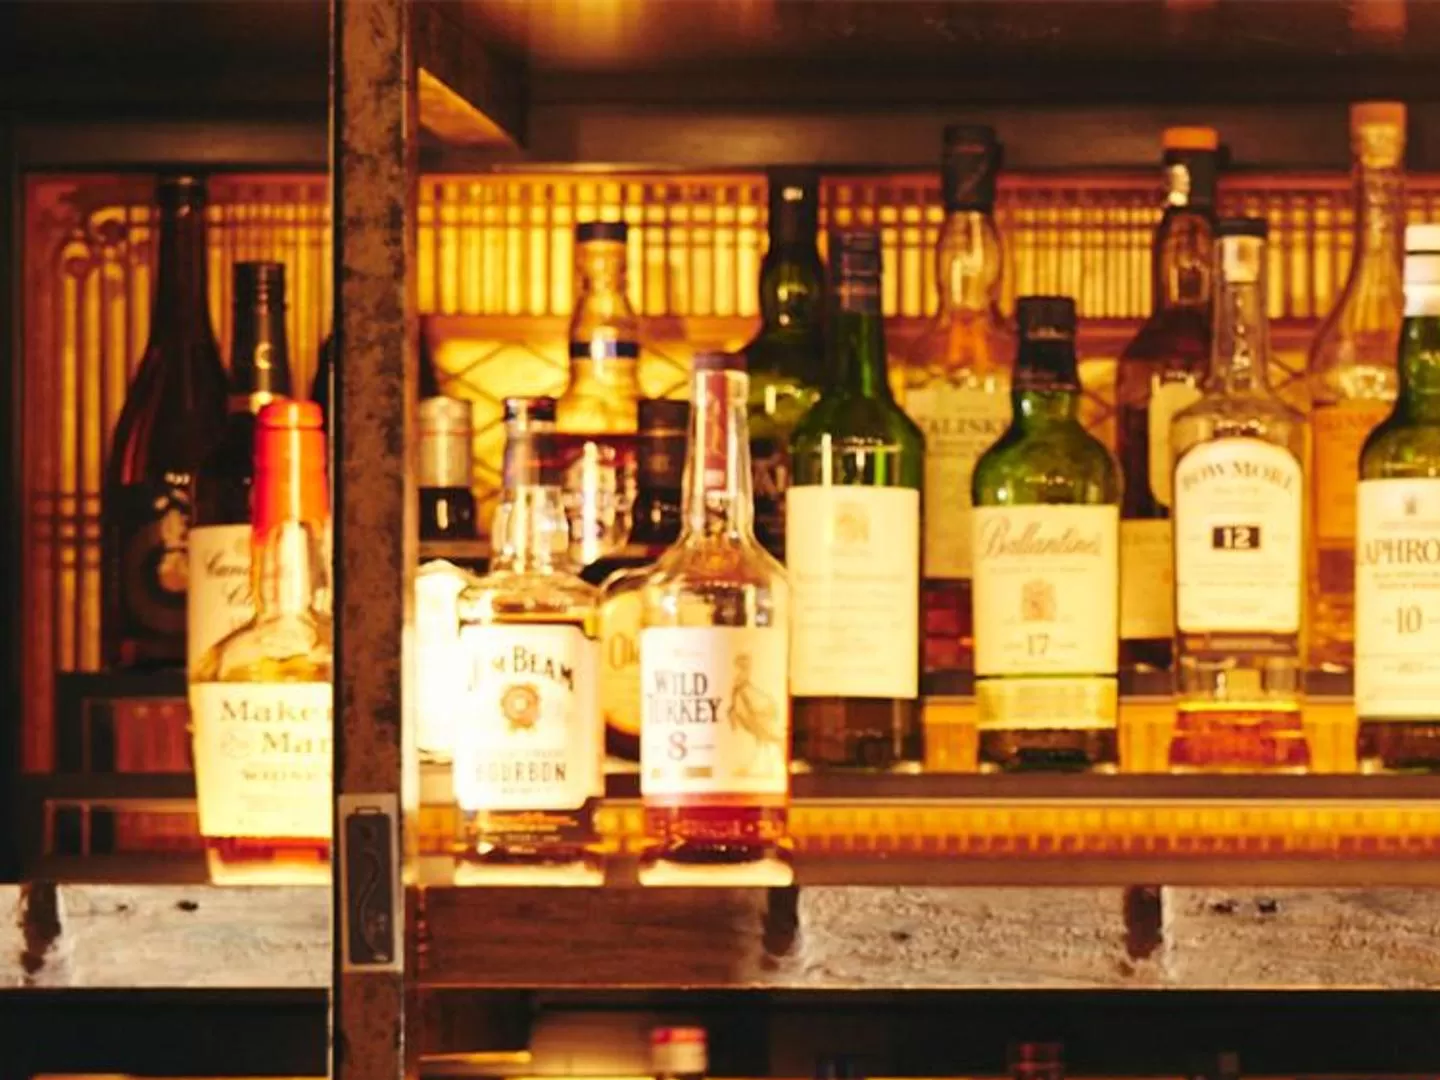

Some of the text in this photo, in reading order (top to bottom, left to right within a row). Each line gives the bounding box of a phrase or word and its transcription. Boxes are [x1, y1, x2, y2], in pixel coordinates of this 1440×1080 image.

[1222, 526, 1251, 550] 12
[1396, 606, 1423, 634] 10
[1027, 632, 1051, 657] 17
[512, 645, 576, 692] BEAM
[654, 671, 709, 697] WILD
[668, 731, 688, 761] 8
